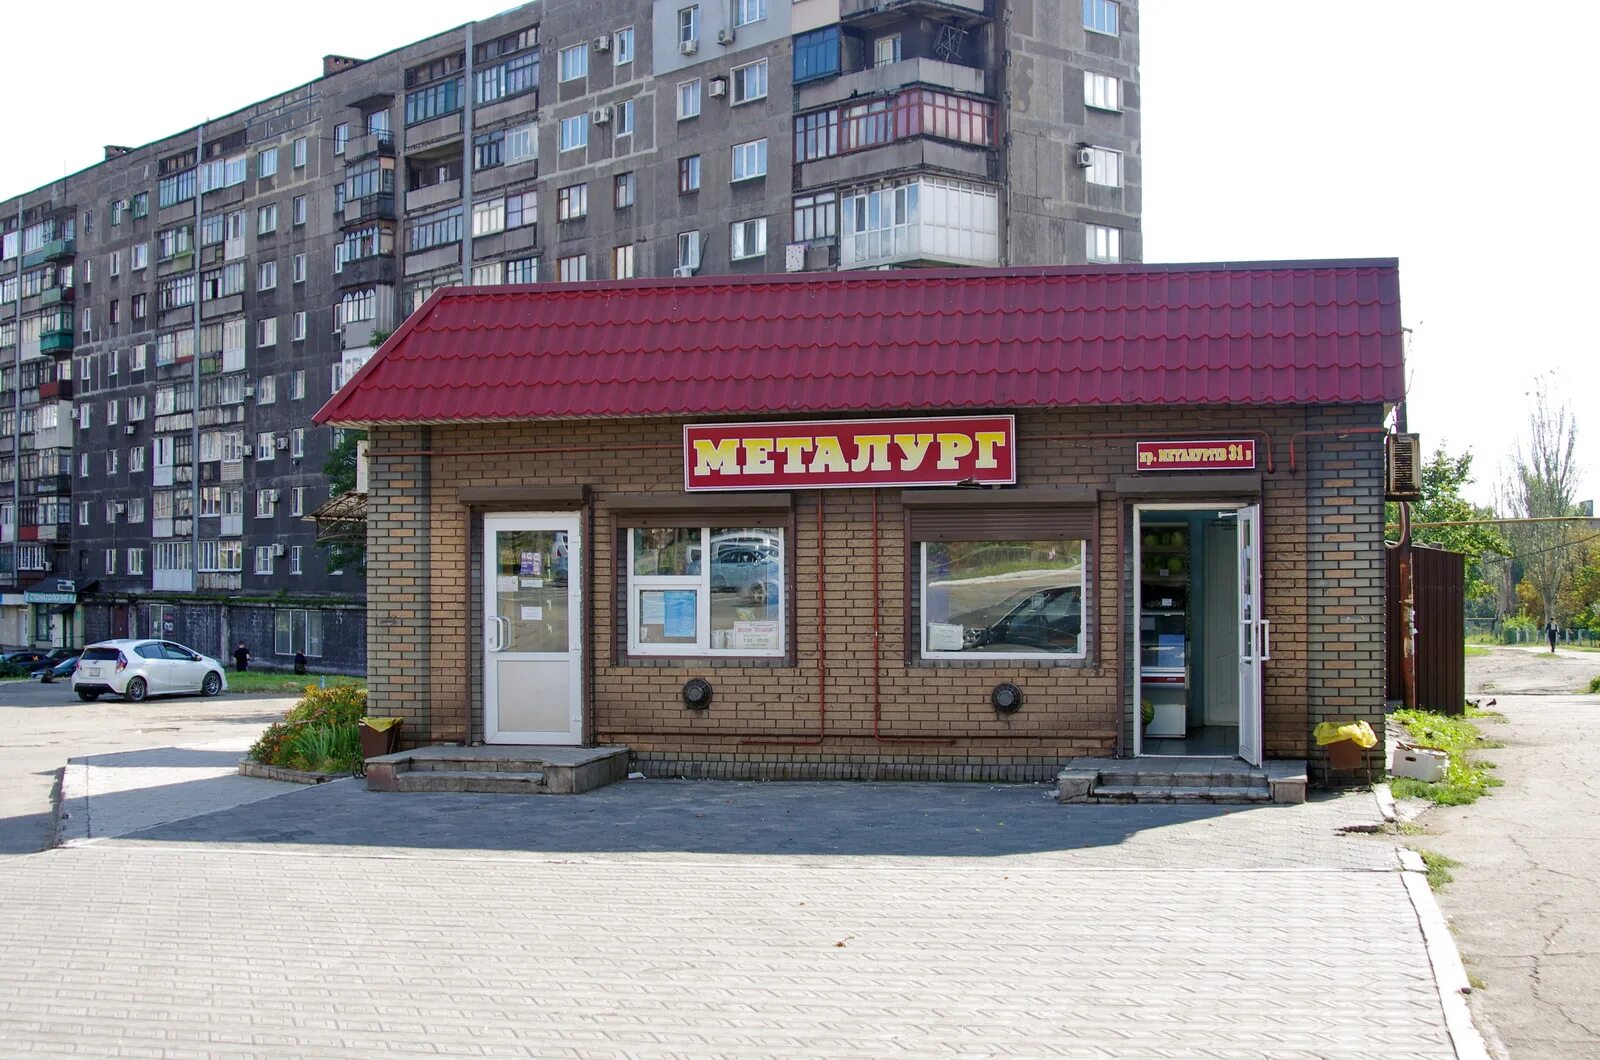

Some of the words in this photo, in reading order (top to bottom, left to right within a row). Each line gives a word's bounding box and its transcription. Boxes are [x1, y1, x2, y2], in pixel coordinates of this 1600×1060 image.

[693, 432, 1006, 475] МЕТАЛУРГ
[1139, 452, 1157, 466] пр.
[1228, 444, 1243, 461] 31
